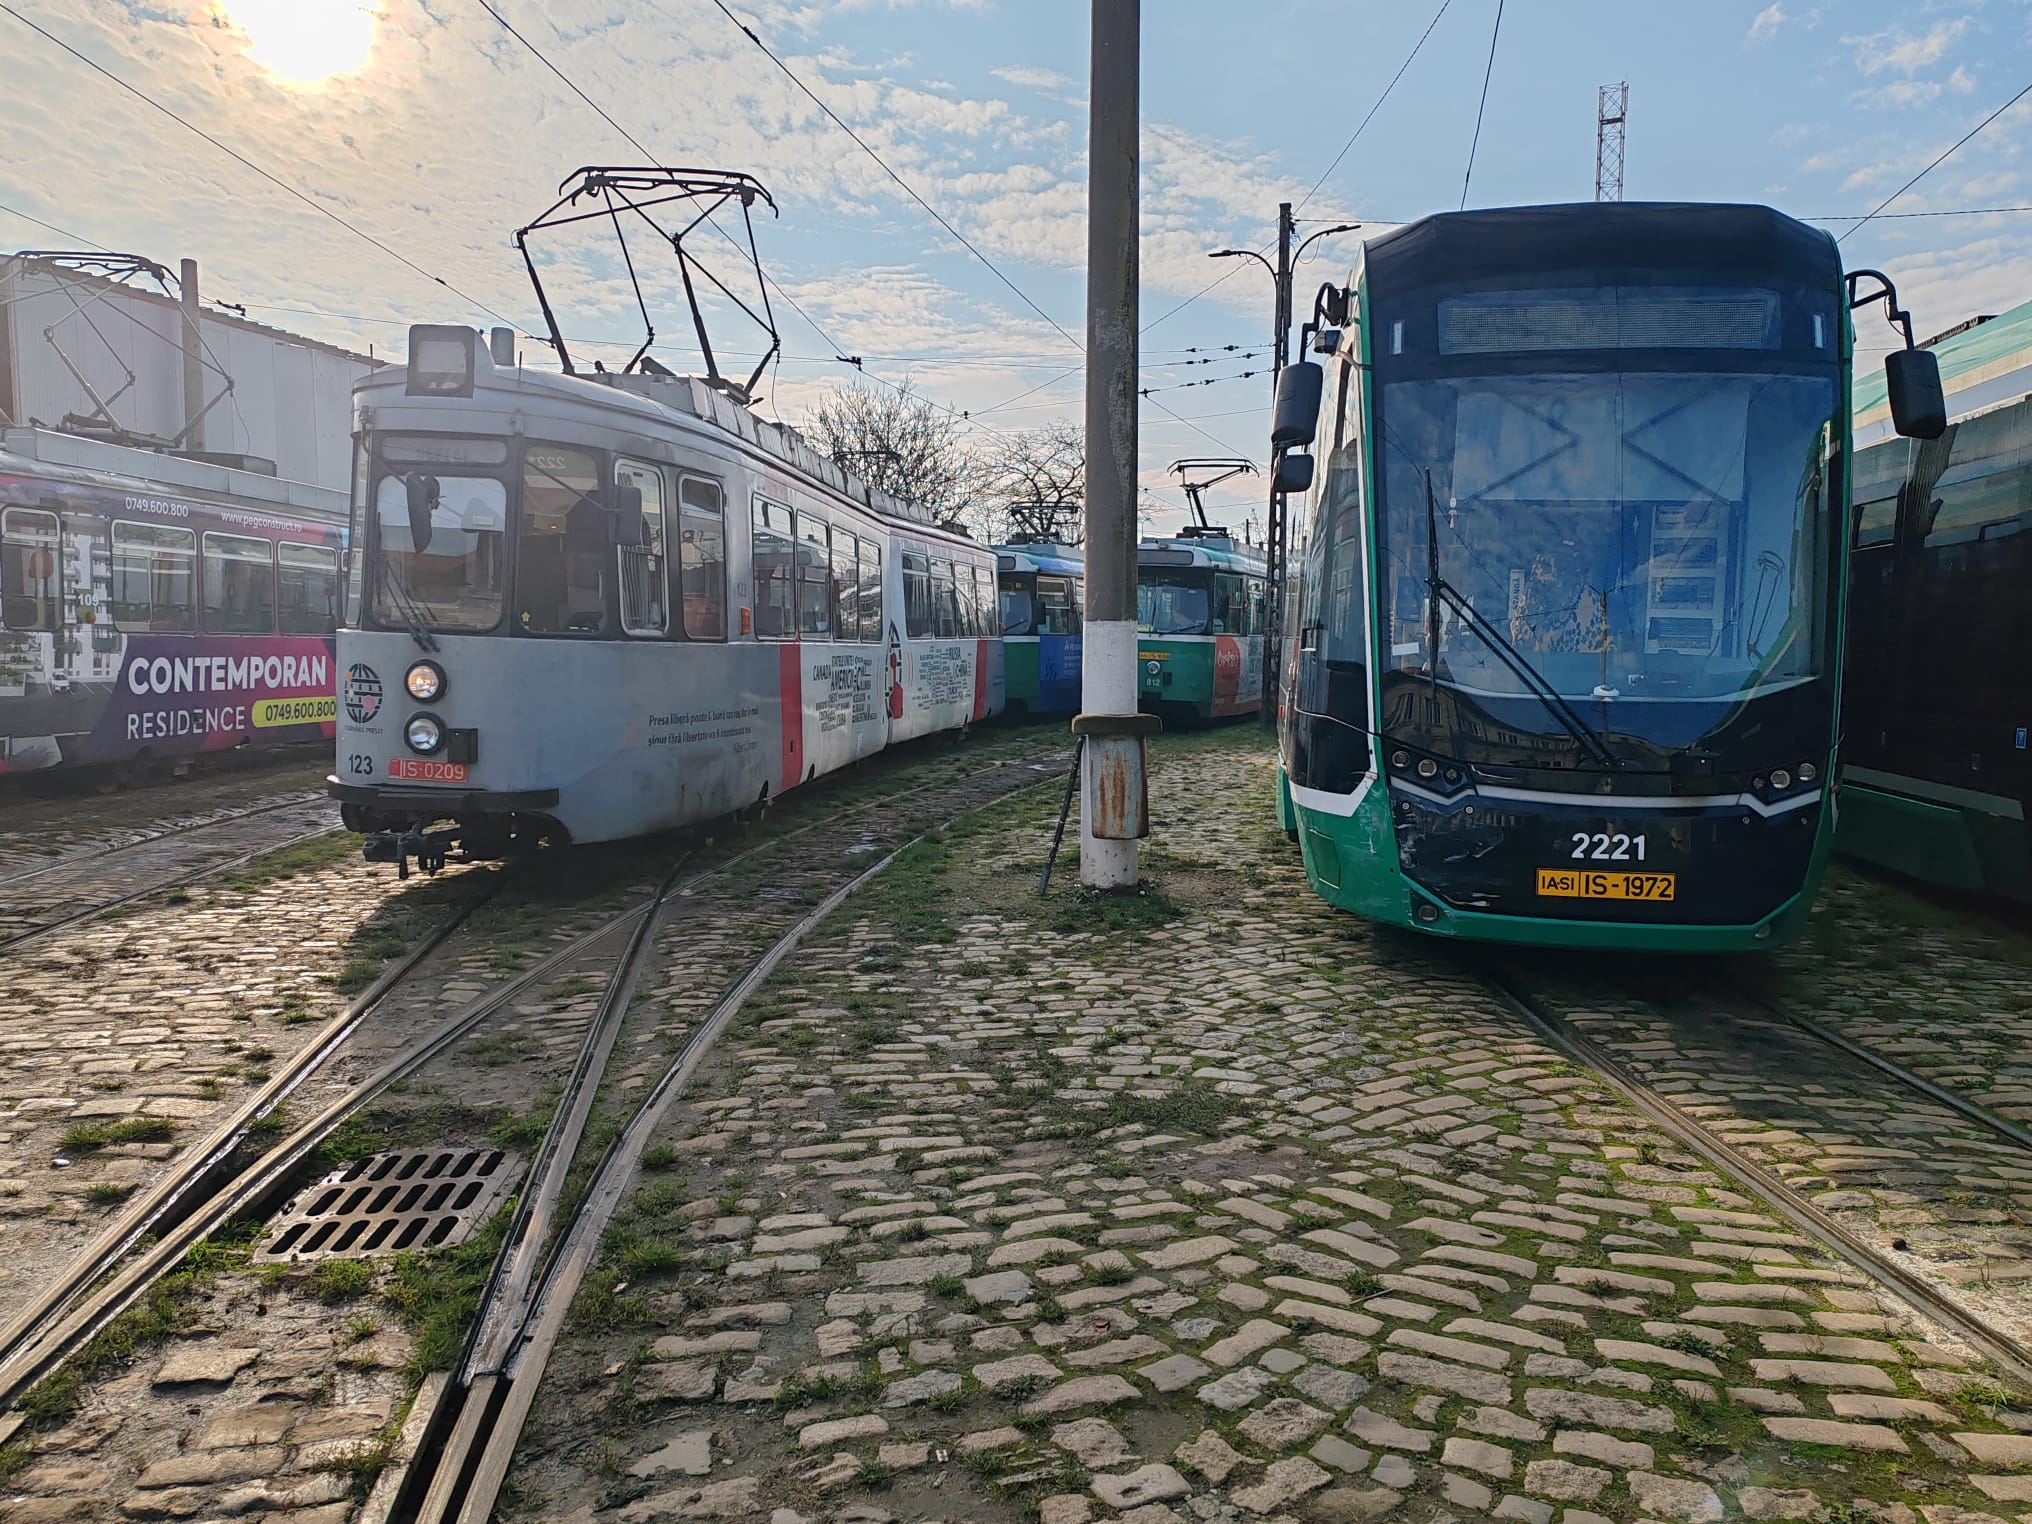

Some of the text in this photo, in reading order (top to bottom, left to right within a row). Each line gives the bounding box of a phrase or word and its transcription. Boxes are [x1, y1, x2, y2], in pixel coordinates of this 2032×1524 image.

[125, 496, 189, 518] 0749.600.800
[221, 511, 303, 533] www.pegconstruct.ro
[78, 593, 99, 606] 109
[128, 655, 327, 695] CONTEMPORAN
[813, 663, 831, 681] CANADA
[265, 701, 336, 721] 0749.600.800
[127, 706, 246, 740] RESIDENCE
[348, 754, 373, 775] 123
[1571, 832, 1646, 861] 2221
